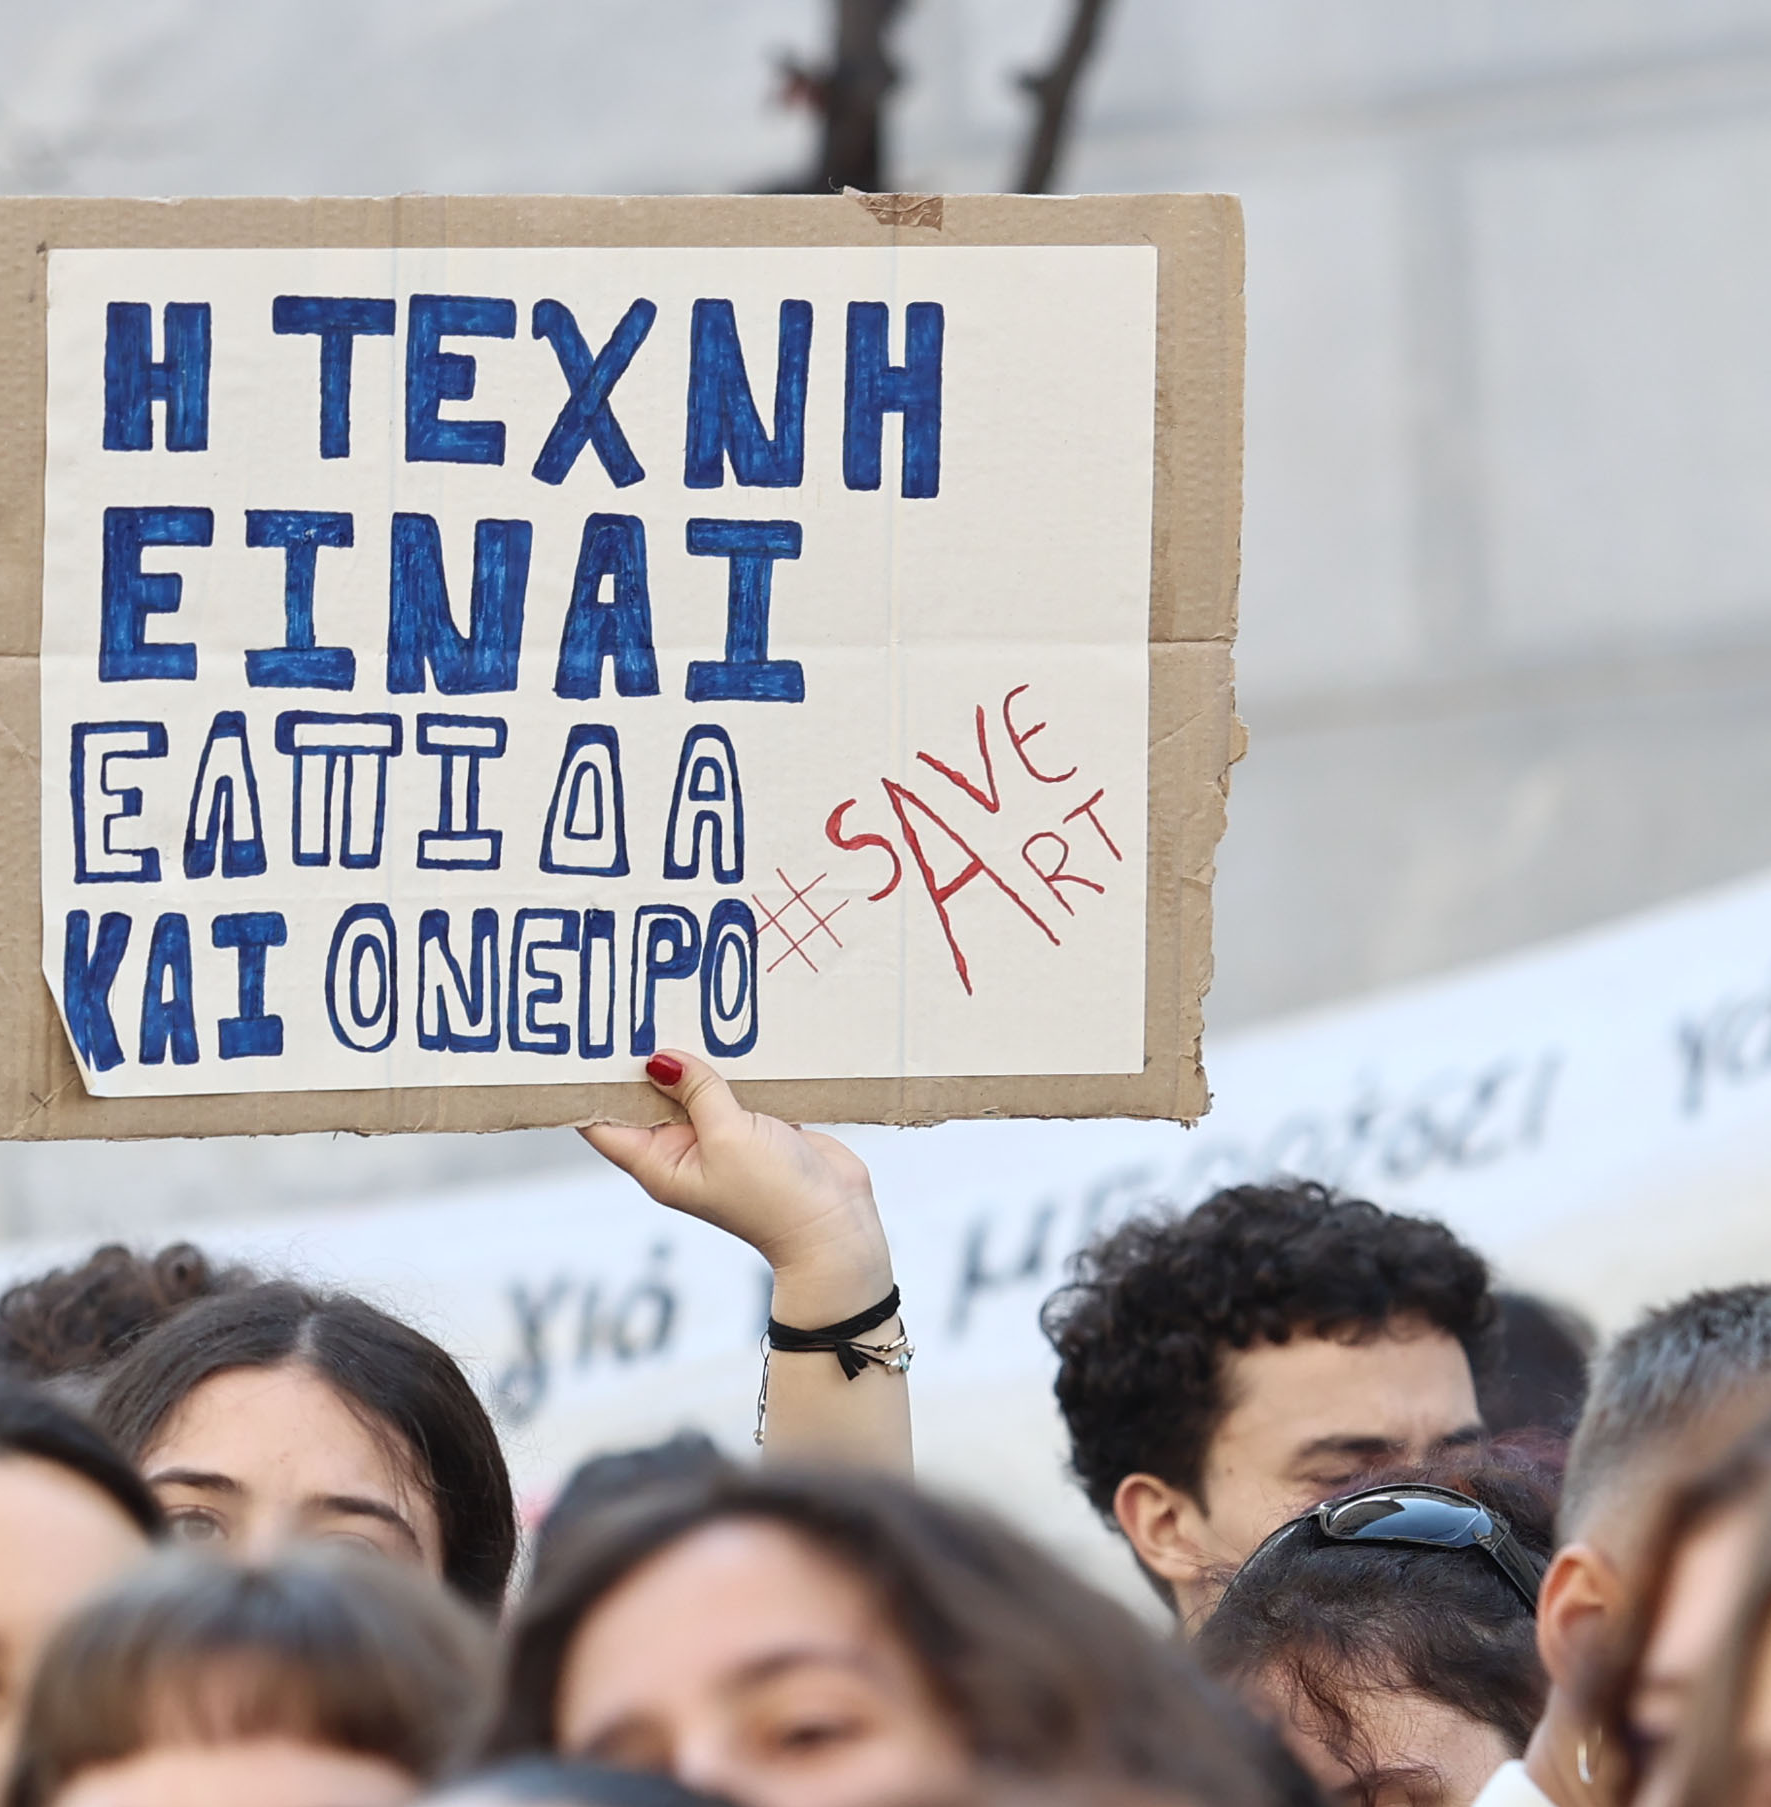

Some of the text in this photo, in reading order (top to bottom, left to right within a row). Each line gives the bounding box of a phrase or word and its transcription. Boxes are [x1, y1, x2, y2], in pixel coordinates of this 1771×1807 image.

[104, 295, 944, 499] Η ΤΕΧΝΗ
[99, 506, 805, 703] ΕΙΝΑΙ
[70, 711, 744, 884] ΕΛΠΙΔΑ
[64, 899, 758, 1072] ΚΑΙ ΟΝΕΙΡΟ
